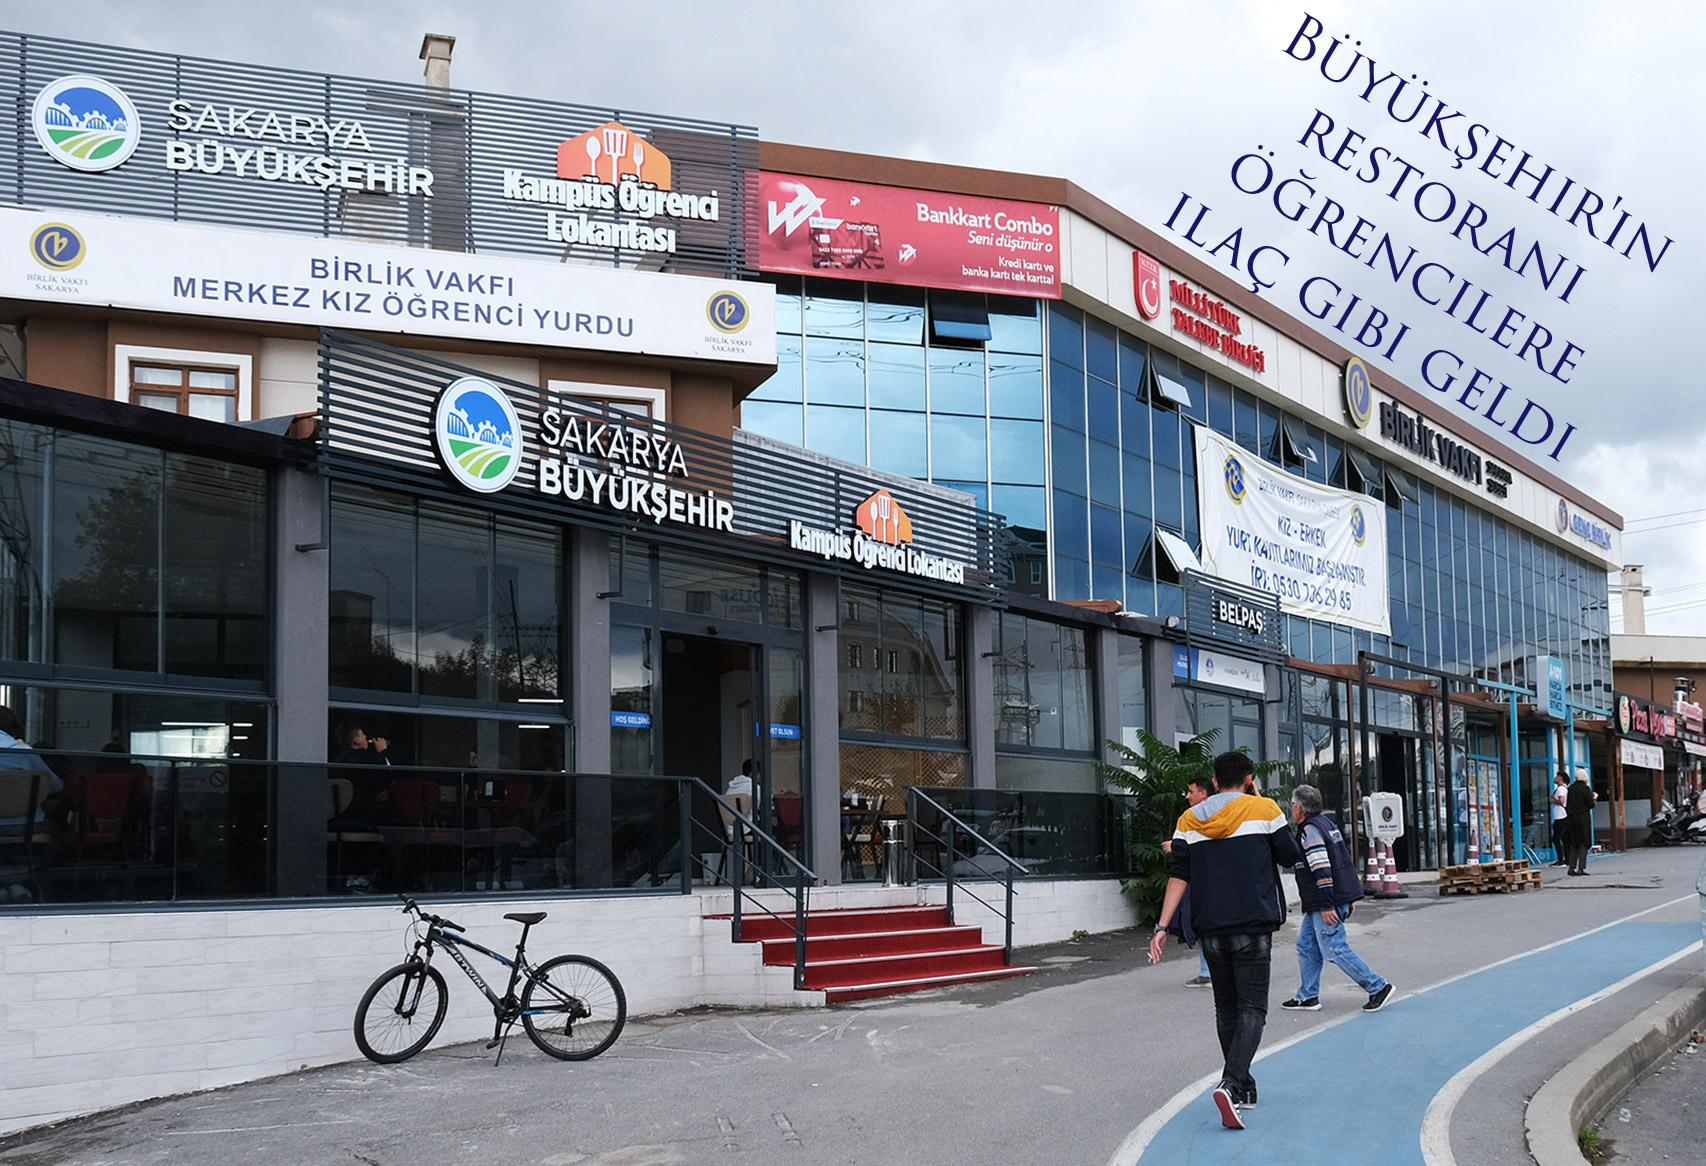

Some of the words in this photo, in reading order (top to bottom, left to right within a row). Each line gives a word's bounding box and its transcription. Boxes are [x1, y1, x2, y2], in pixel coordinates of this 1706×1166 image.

[168, 99, 373, 152] SAKARYA
[166, 138, 435, 197] BÜYÜKŞEHİR
[502, 167, 616, 212] Kampüs
[617, 173, 719, 222] Öğrenci
[547, 211, 677, 254] Lokantası
[916, 203, 992, 229] Bankkart
[994, 212, 1054, 236] Combo
[967, 230, 993, 247] Seni
[995, 234, 1044, 252] düşünür
[1044, 242, 1054, 252] o
[310, 255, 416, 288] BİRLİK
[425, 269, 514, 297] VAKFI
[962, 265, 989, 278] banka
[1011, 271, 1026, 282] tek
[998, 256, 1022, 270] Kredi
[1043, 265, 1054, 273] ve
[35, 284, 80, 294] SAKARYA
[172, 275, 311, 309] MERKEZ
[322, 289, 372, 314] KIZ
[382, 291, 524, 328] ÖĞRENCİ
[533, 308, 634, 338] YURDU
[540, 409, 689, 478] SAKARYA
[1379, 400, 1436, 461] BİRLİK
[1436, 433, 1483, 485] VAKFI
[538, 456, 735, 533] BÜYÜKŞEHİR
[789, 519, 852, 561] Kampüs
[853, 530, 906, 569] Öğrenci
[907, 547, 965, 585] Lokantası
[1226, 524, 1252, 553] YURT
[1300, 522, 1327, 549] ERKEK
[1272, 572, 1301, 601] 0530
[1324, 587, 1338, 607] 29
[1340, 589, 1352, 611] 85
[1219, 600, 1264, 635] BELPAŞ
